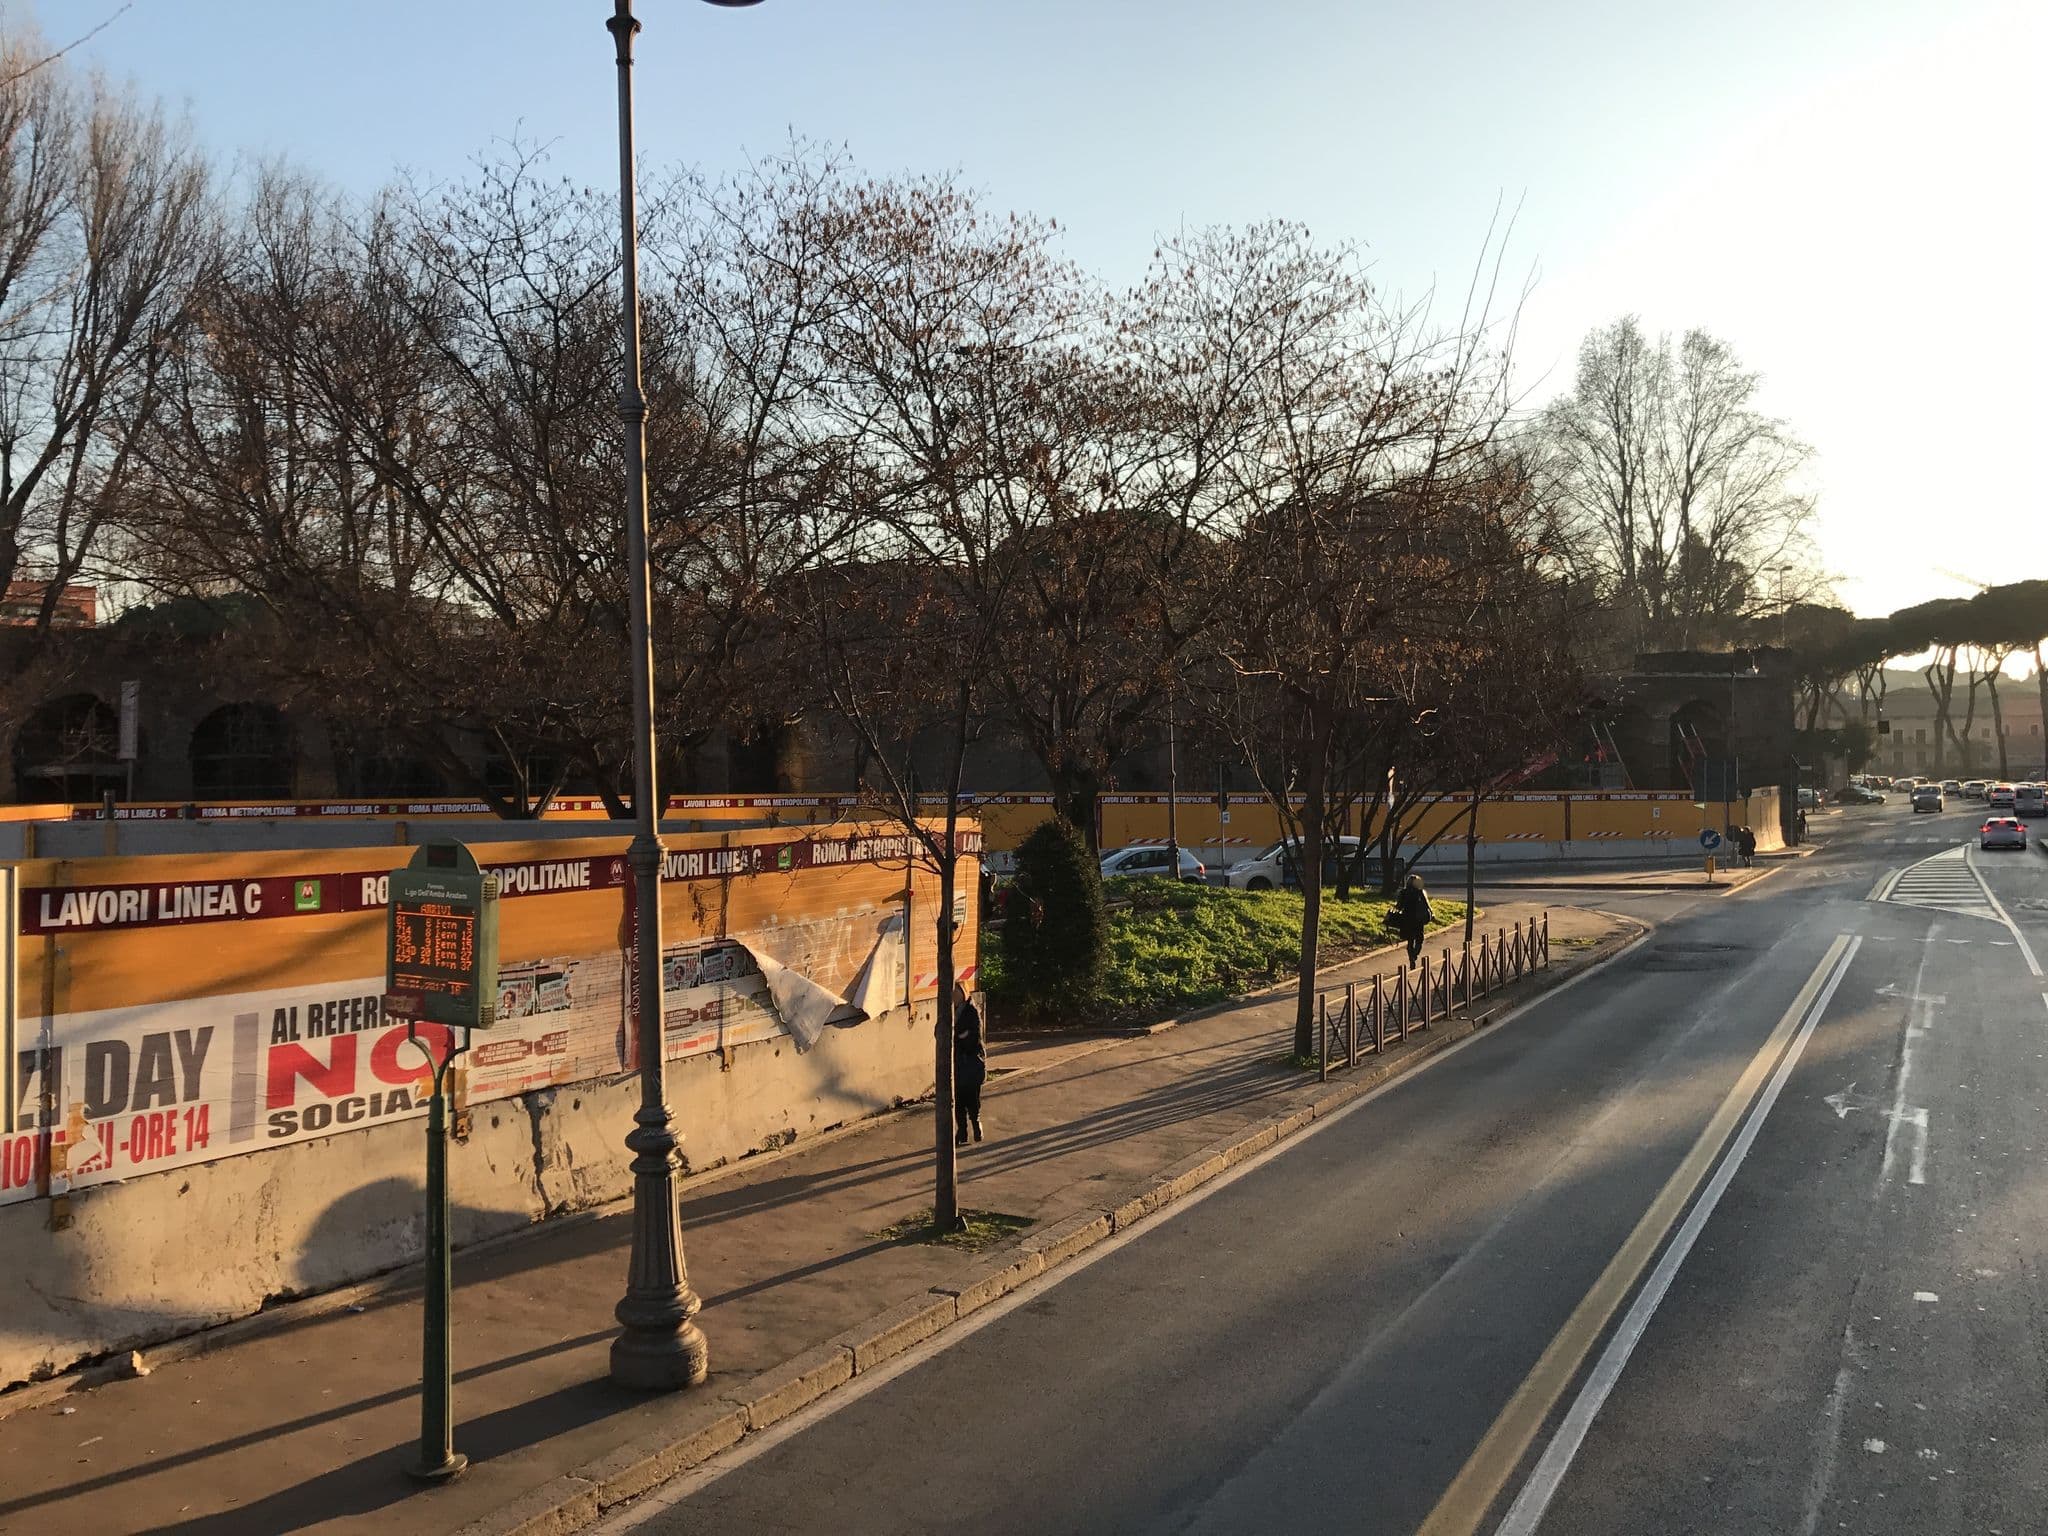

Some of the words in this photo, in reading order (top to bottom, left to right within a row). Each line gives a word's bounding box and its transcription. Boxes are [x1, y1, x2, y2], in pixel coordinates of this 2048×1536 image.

[131, 808, 158, 819] LINEA
[159, 808, 167, 818] C
[201, 807, 228, 817] ROMA
[229, 806, 297, 817] METROPOLITANE
[320, 805, 349, 815] LAVORI
[350, 804, 373, 814] LINEA
[373, 804, 380, 814] C
[408, 804, 431, 814] ROMA
[432, 803, 491, 814] METROPOLITANE
[683, 799, 706, 808] LAVORI
[707, 799, 725, 808] LINEA
[725, 798, 731, 807] C
[753, 798, 771, 807] ROMA
[772, 798, 820, 807] METROPOLITANE
[661, 852, 703, 879] AVORI
[708, 849, 748, 875] LINEA
[752, 849, 762, 870] C
[812, 842, 847, 865] ROMA
[361, 875, 388, 906] RO
[39, 888, 149, 928] LAVORI
[158, 883, 238, 920] LINEA
[243, 883, 262, 915] C
[270, 1006, 302, 1045] AL
[307, 994, 408, 1039] REFERE
[83, 1026, 214, 1120] DAY
[266, 1021, 456, 1110] NO
[185, 1104, 210, 1152] 14
